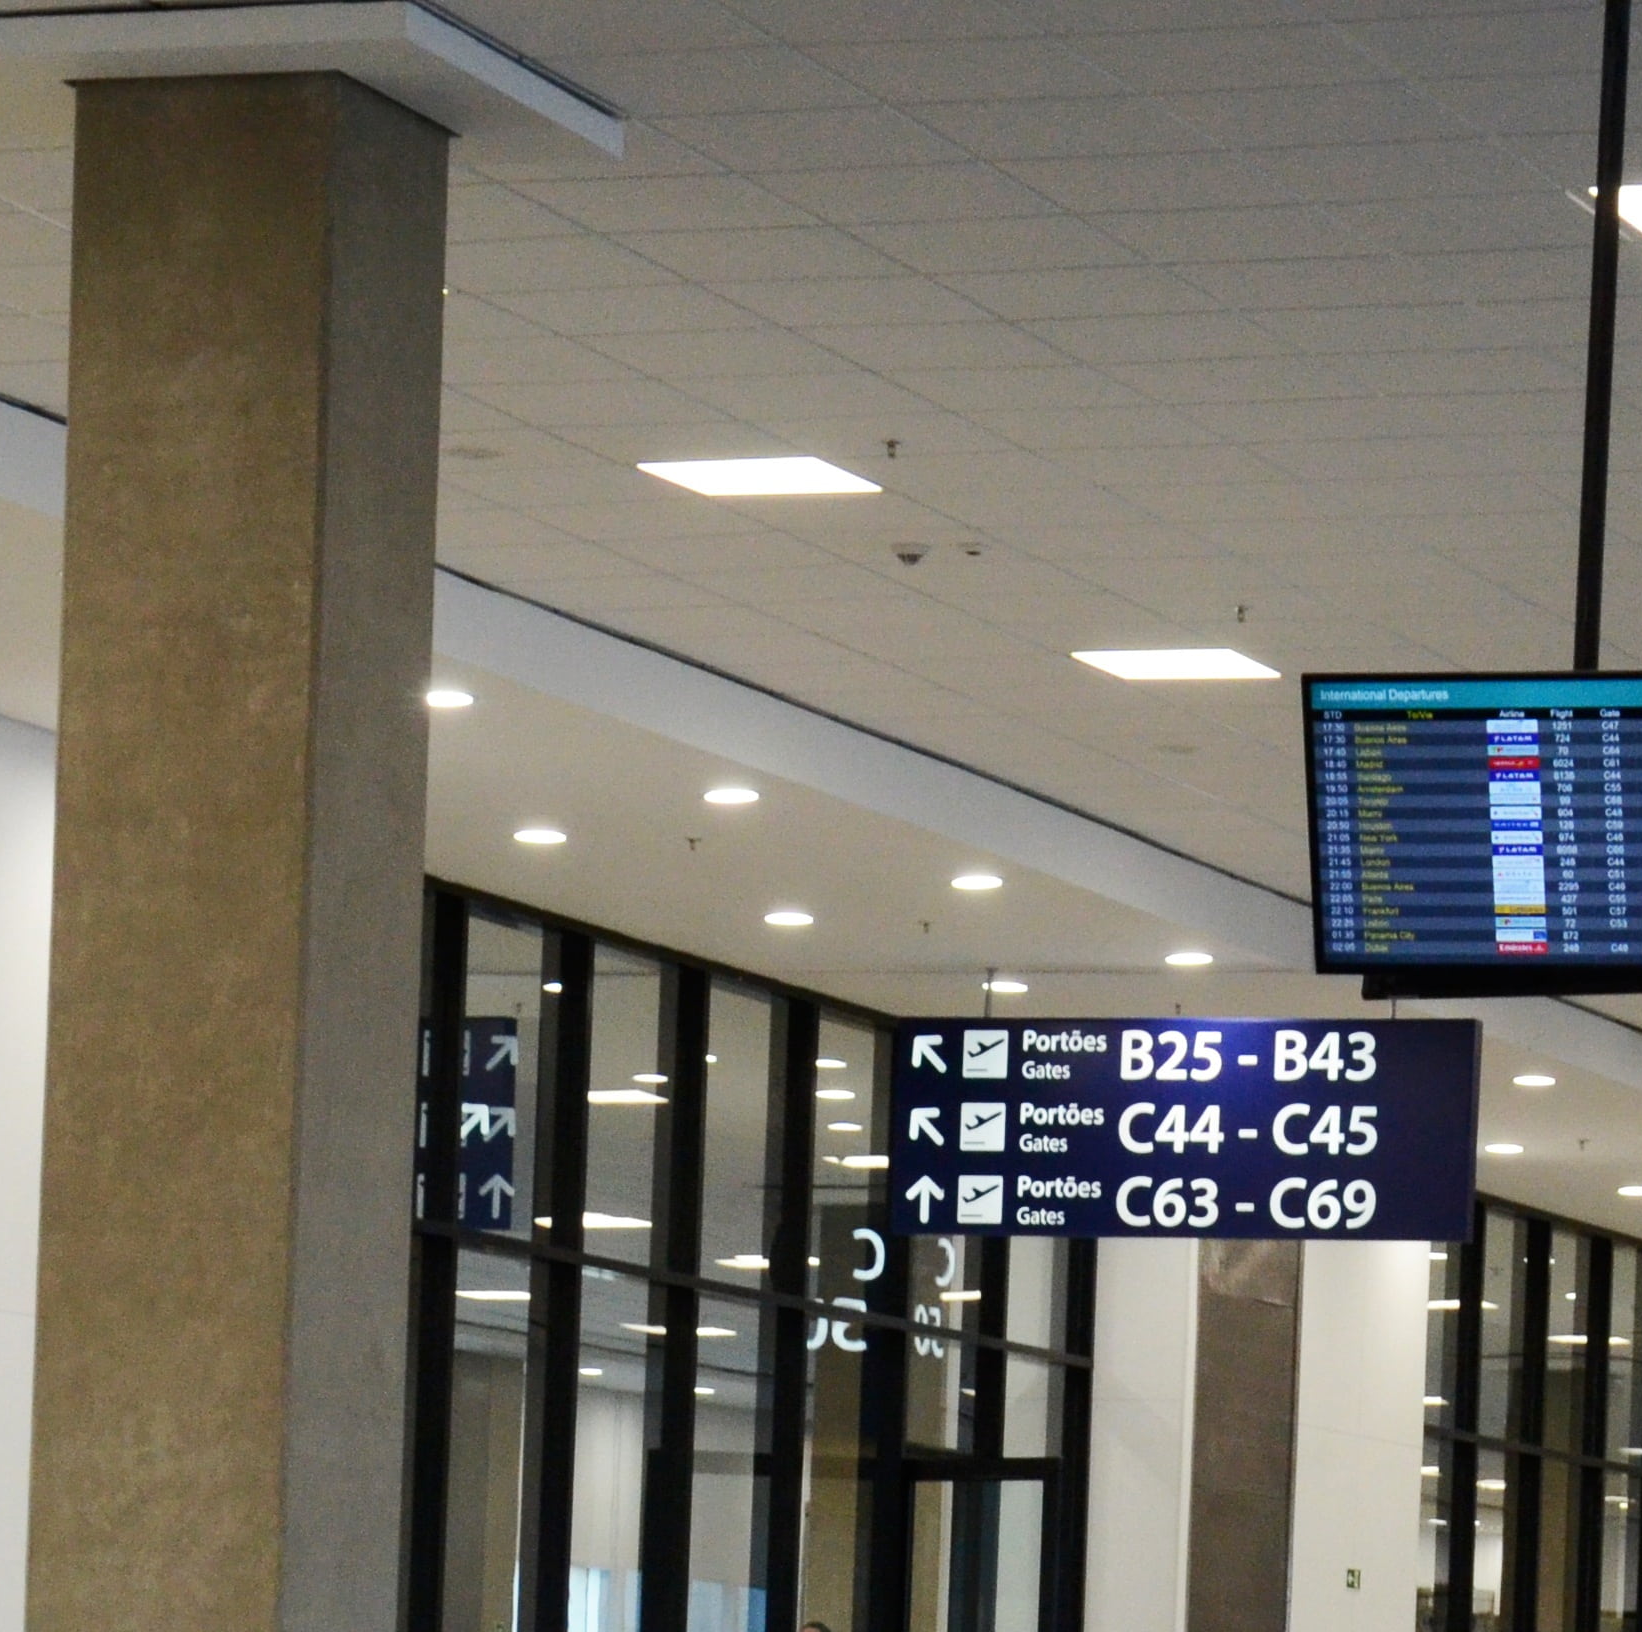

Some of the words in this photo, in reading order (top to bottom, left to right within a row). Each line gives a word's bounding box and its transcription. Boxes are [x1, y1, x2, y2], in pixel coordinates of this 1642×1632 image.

[1320, 688, 1386, 702] International
[1388, 688, 1450, 704] Departures
[1323, 710, 1342, 720] STD
[1499, 709, 1525, 718] Airline
[1550, 709, 1574, 720] Flight
[1600, 708, 1621, 718] Gate
[1023, 1030, 1107, 1052] Portões
[1120, 1029, 1222, 1082] B25
[1237, 1055, 1258, 1066] -
[1274, 1030, 1377, 1082] B43
[1022, 1061, 1071, 1080] Gates
[1020, 1103, 1104, 1125] Portões
[1118, 1102, 1225, 1154] C44
[1238, 1129, 1258, 1139] -
[1272, 1103, 1378, 1156] C45
[1019, 1134, 1068, 1152] Gates
[1017, 1175, 1102, 1198] Portões
[1116, 1176, 1219, 1227] C63
[1235, 1203, 1255, 1212] -
[1269, 1177, 1377, 1230] C69
[1016, 1207, 1065, 1225] Gates
